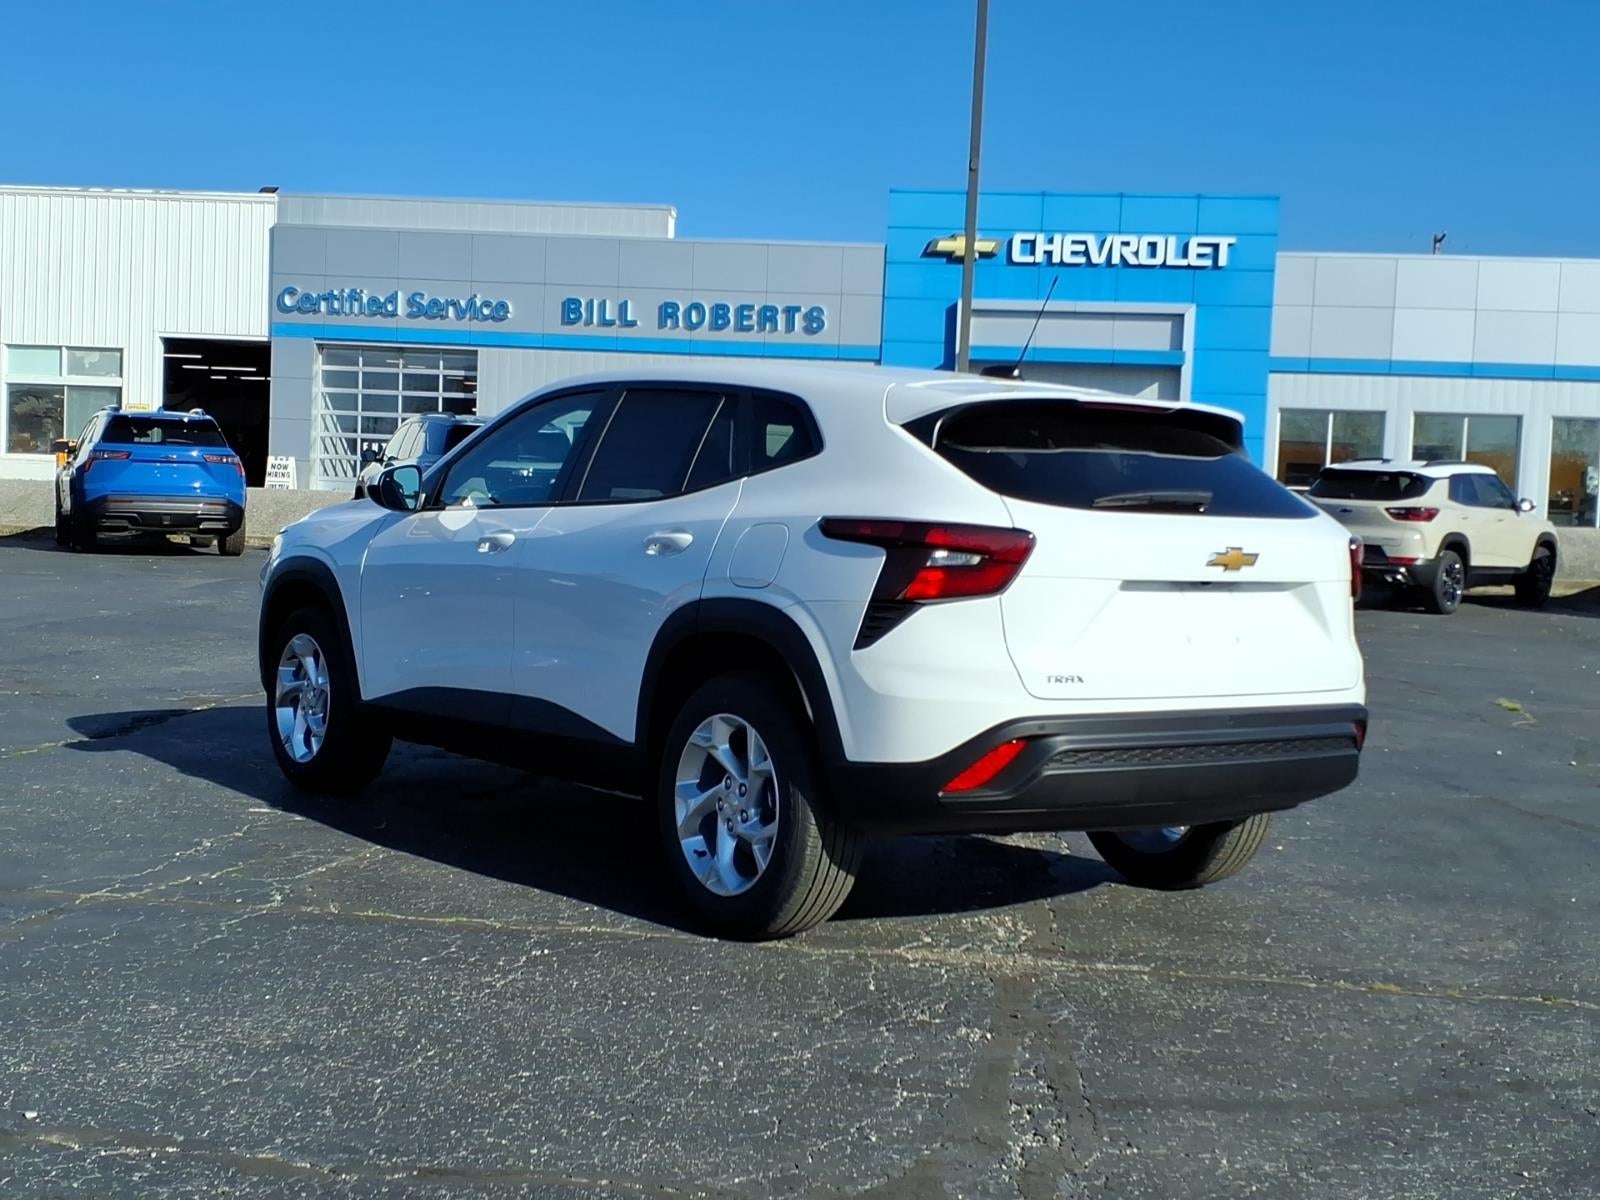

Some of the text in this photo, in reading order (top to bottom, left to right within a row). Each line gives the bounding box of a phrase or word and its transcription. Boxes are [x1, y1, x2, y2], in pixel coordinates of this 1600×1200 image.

[1010, 232, 1237, 268] CHEVROLET
[277, 286, 512, 323] Certified Service
[561, 297, 826, 335] BILL ROBERTS
[267, 471, 291, 479] HIRING
[271, 463, 290, 471] NOW
[1047, 674, 1085, 684] TRAX
